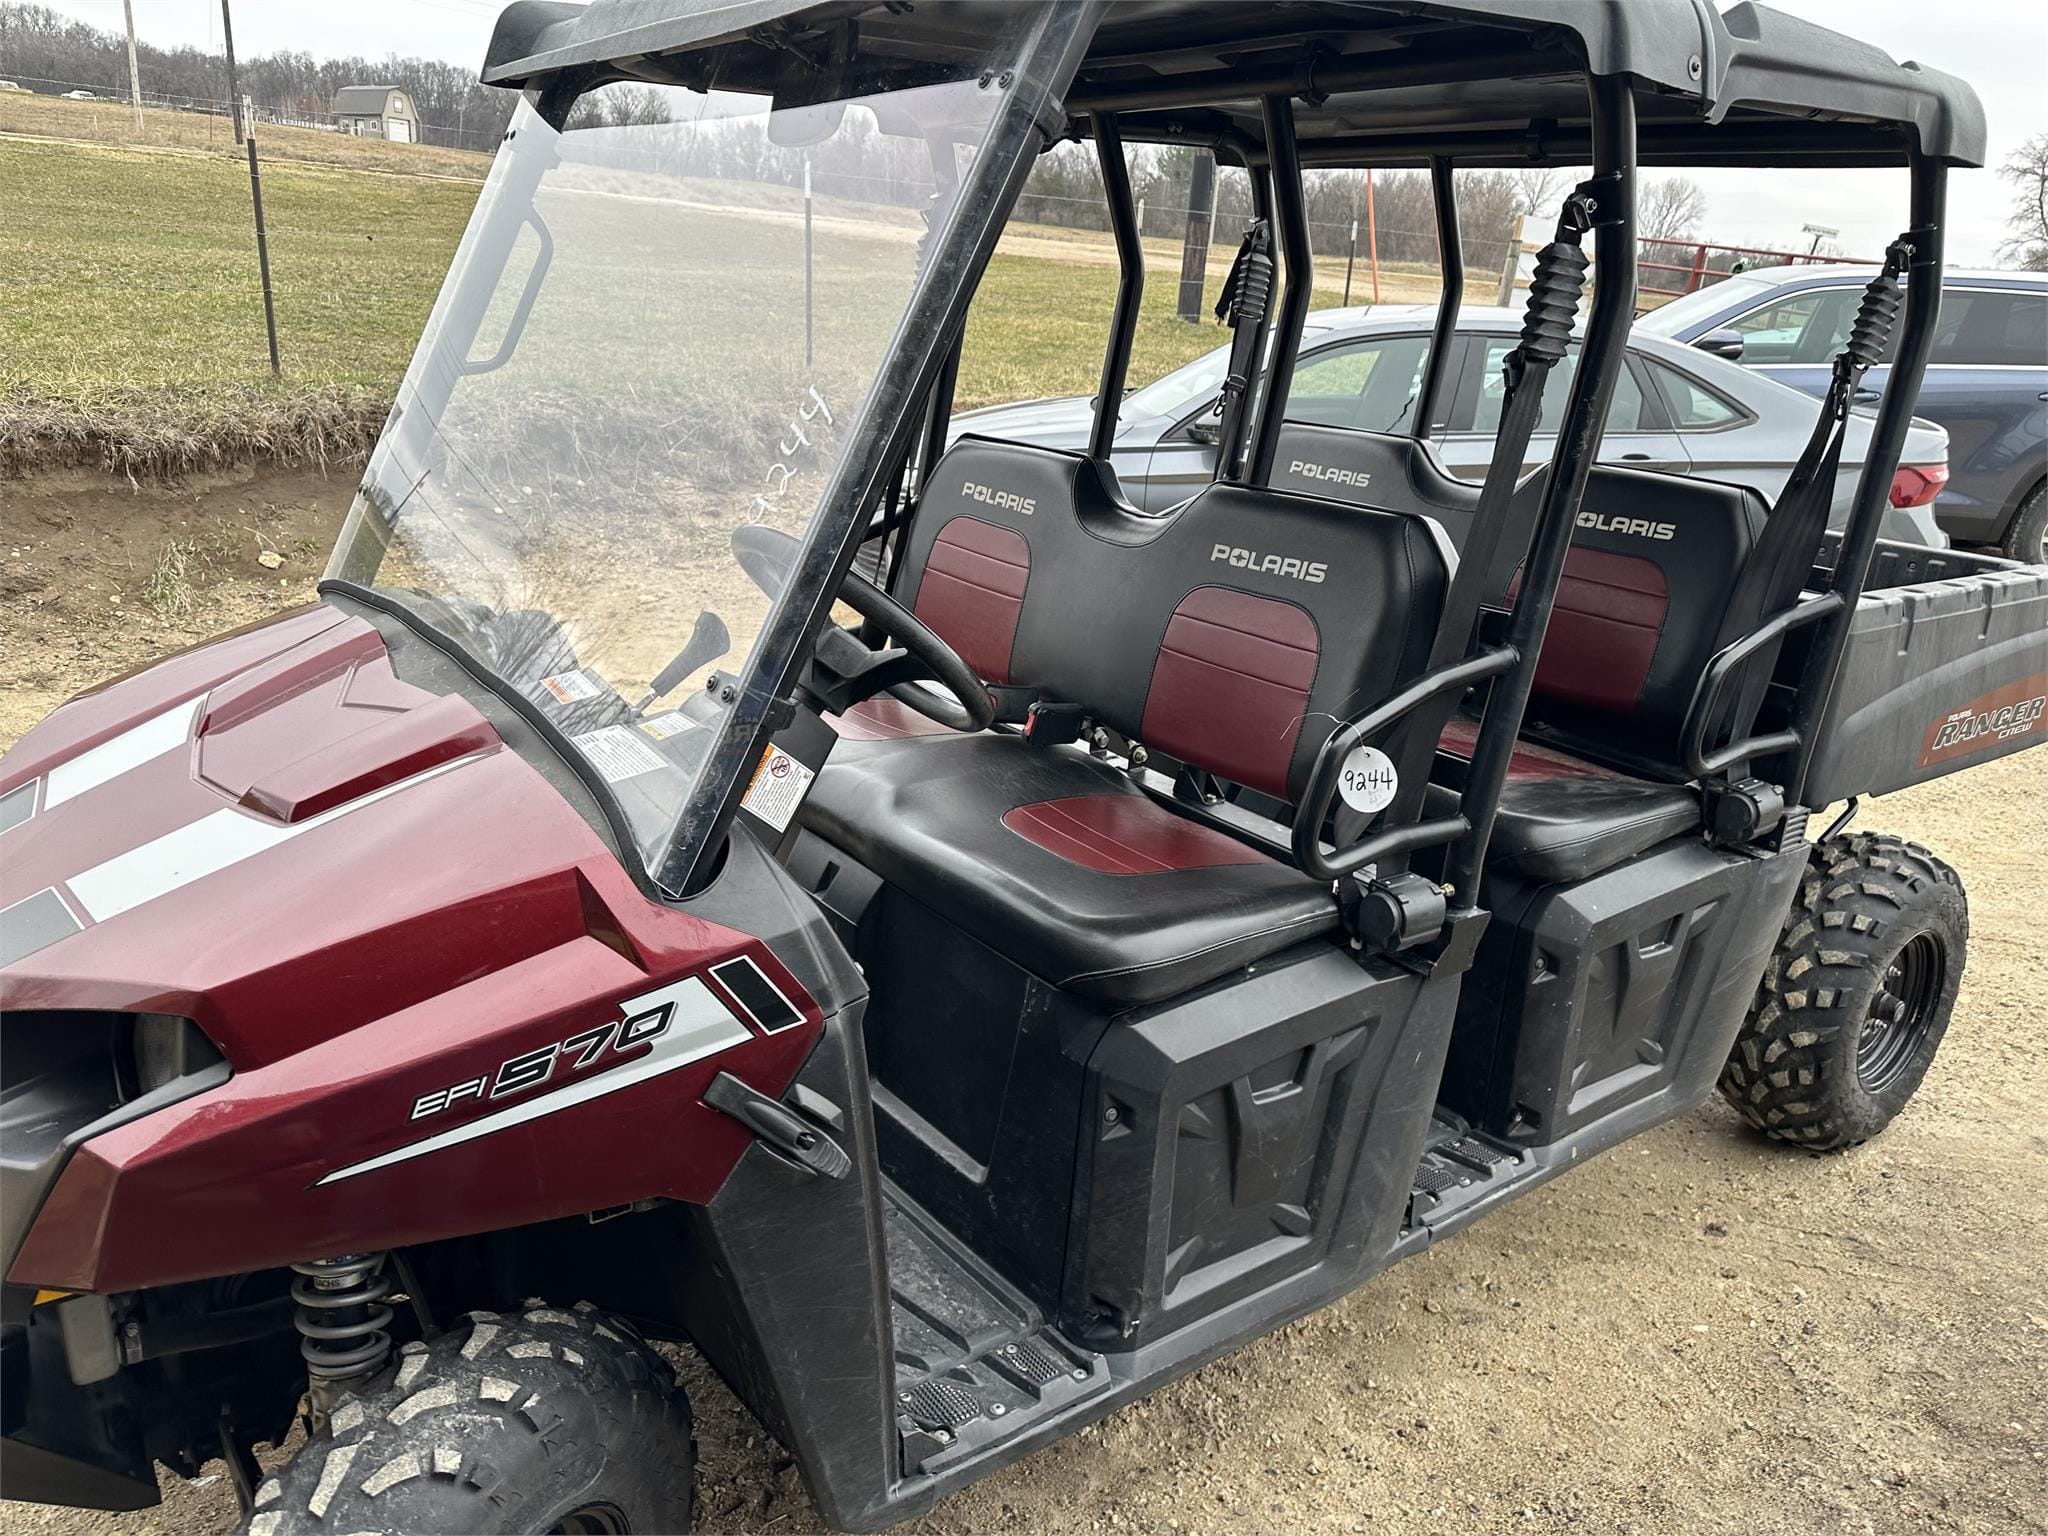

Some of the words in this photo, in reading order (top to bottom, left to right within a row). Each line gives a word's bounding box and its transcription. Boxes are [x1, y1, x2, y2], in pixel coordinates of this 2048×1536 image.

[747, 384, 833, 524] 9244
[1289, 461, 1371, 487] POLARIS
[961, 482, 1036, 515] POLARIS
[1576, 511, 1676, 540] OLARIS
[1210, 544, 1328, 583] POLARIS
[1932, 696, 2046, 750] RANGER
[1948, 709, 1972, 722] POLARIS
[1344, 767, 1393, 791] 9244
[410, 1076, 487, 1119] EFI
[490, 1001, 678, 1099] 570
